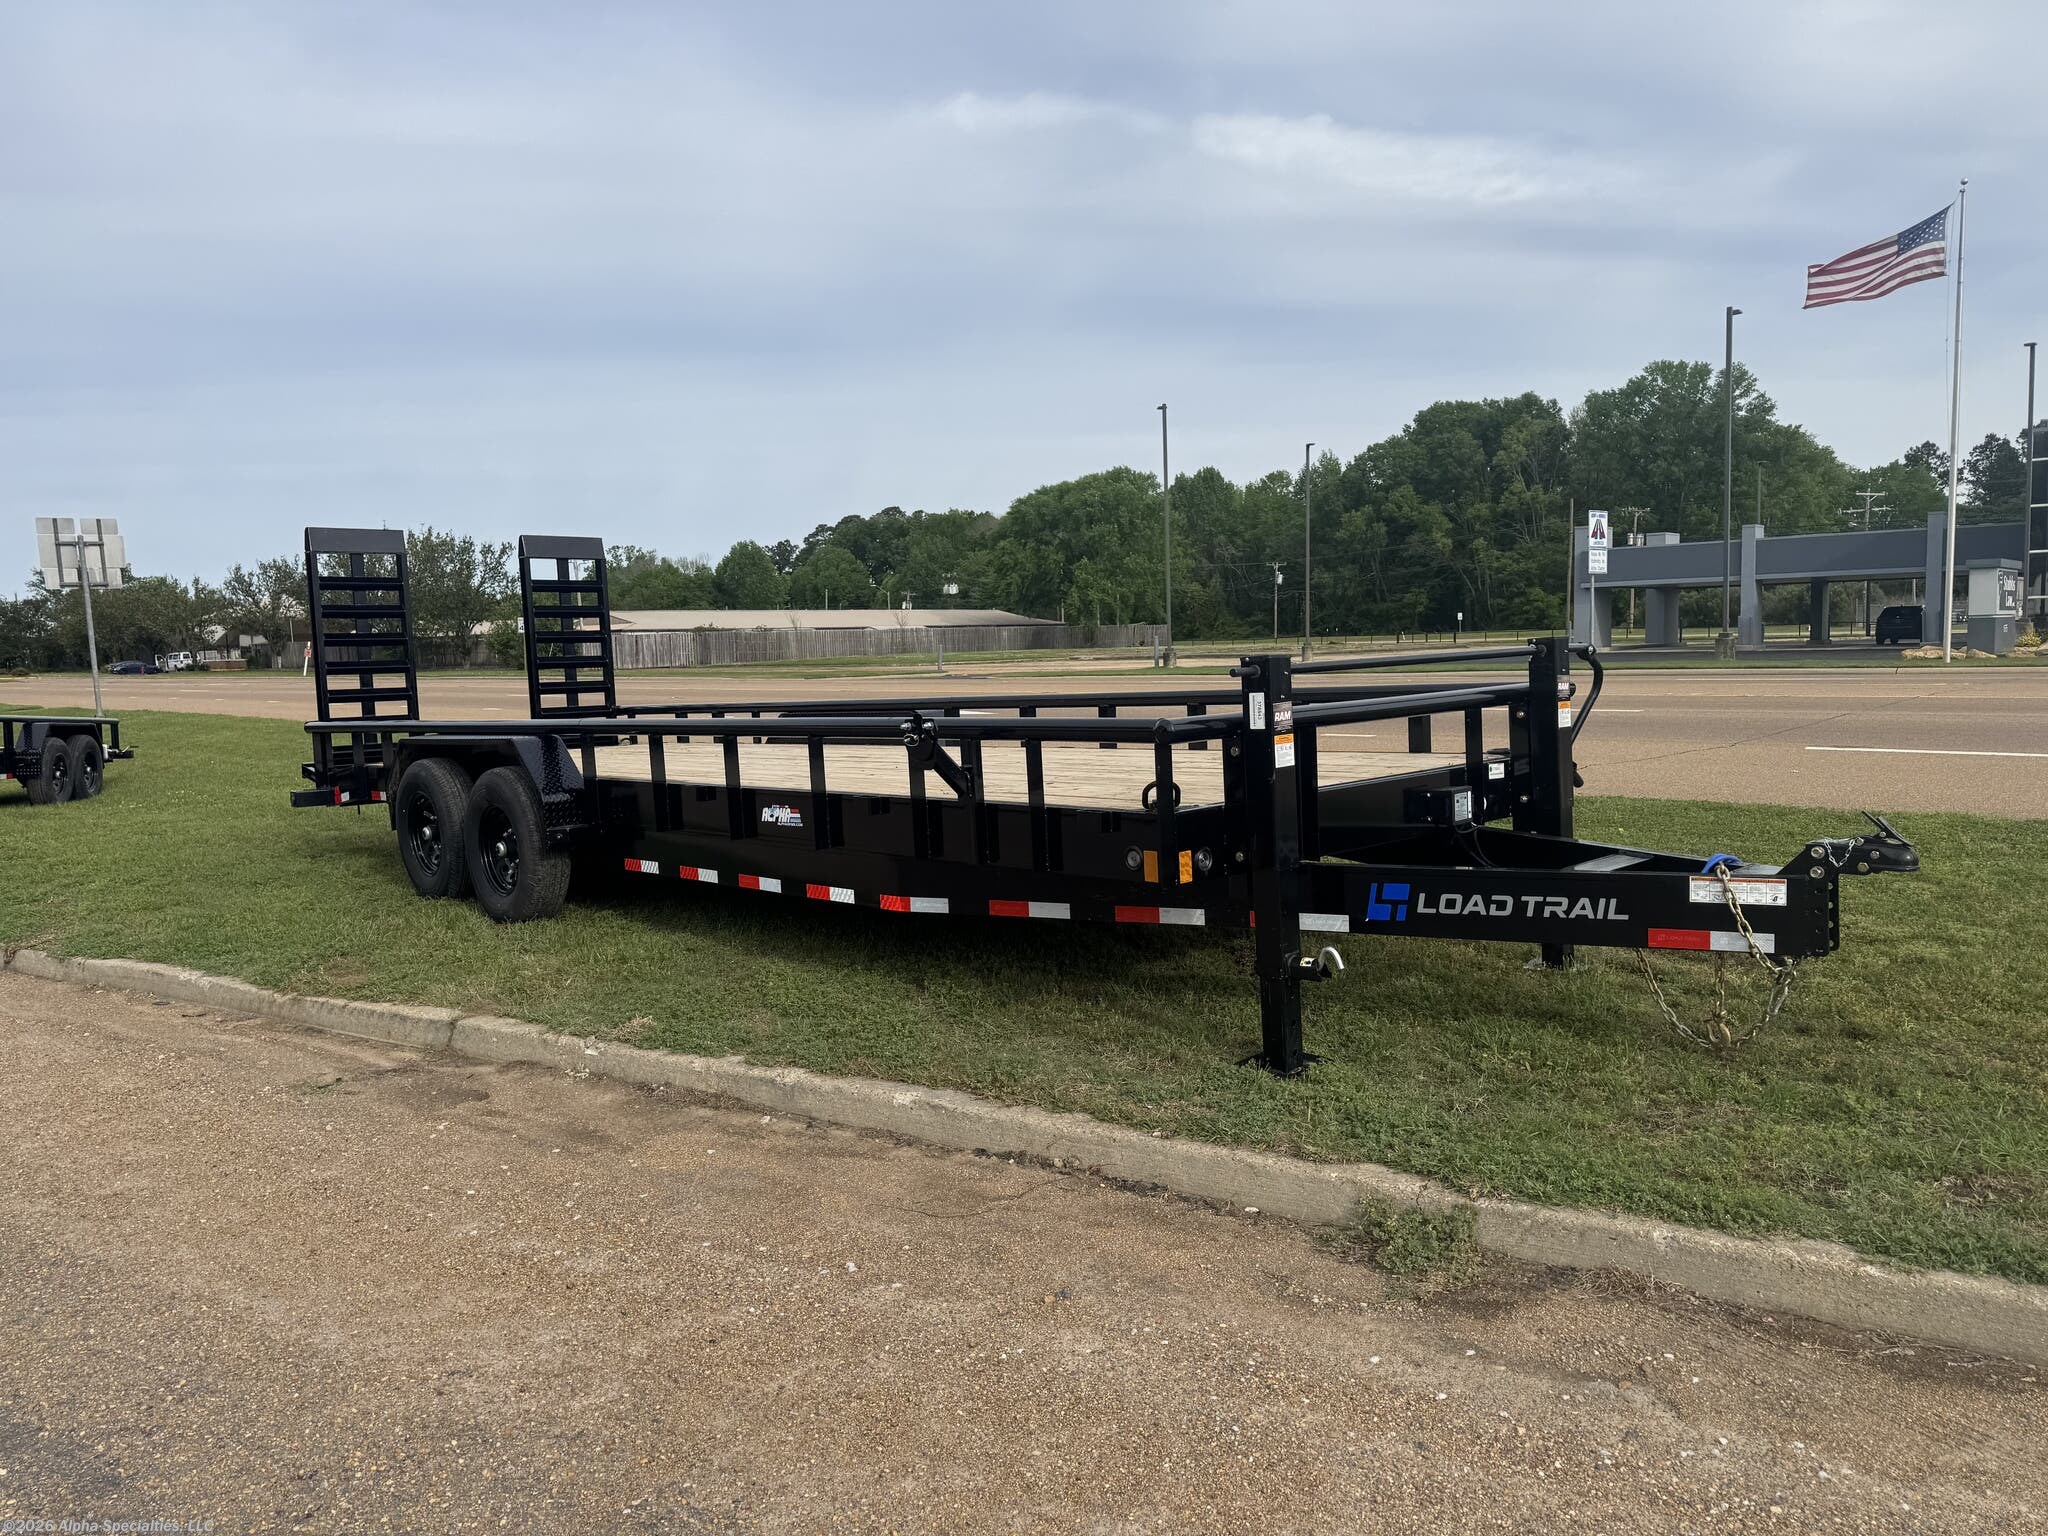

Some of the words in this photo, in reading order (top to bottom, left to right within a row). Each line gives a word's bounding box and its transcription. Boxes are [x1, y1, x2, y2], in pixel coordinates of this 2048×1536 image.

[1558, 682, 1570, 690] RAM
[1274, 711, 1292, 722] RAM
[761, 807, 791, 823] ALPHA
[1416, 892, 1514, 916] LOAD
[1520, 895, 1630, 921] TRAIL
